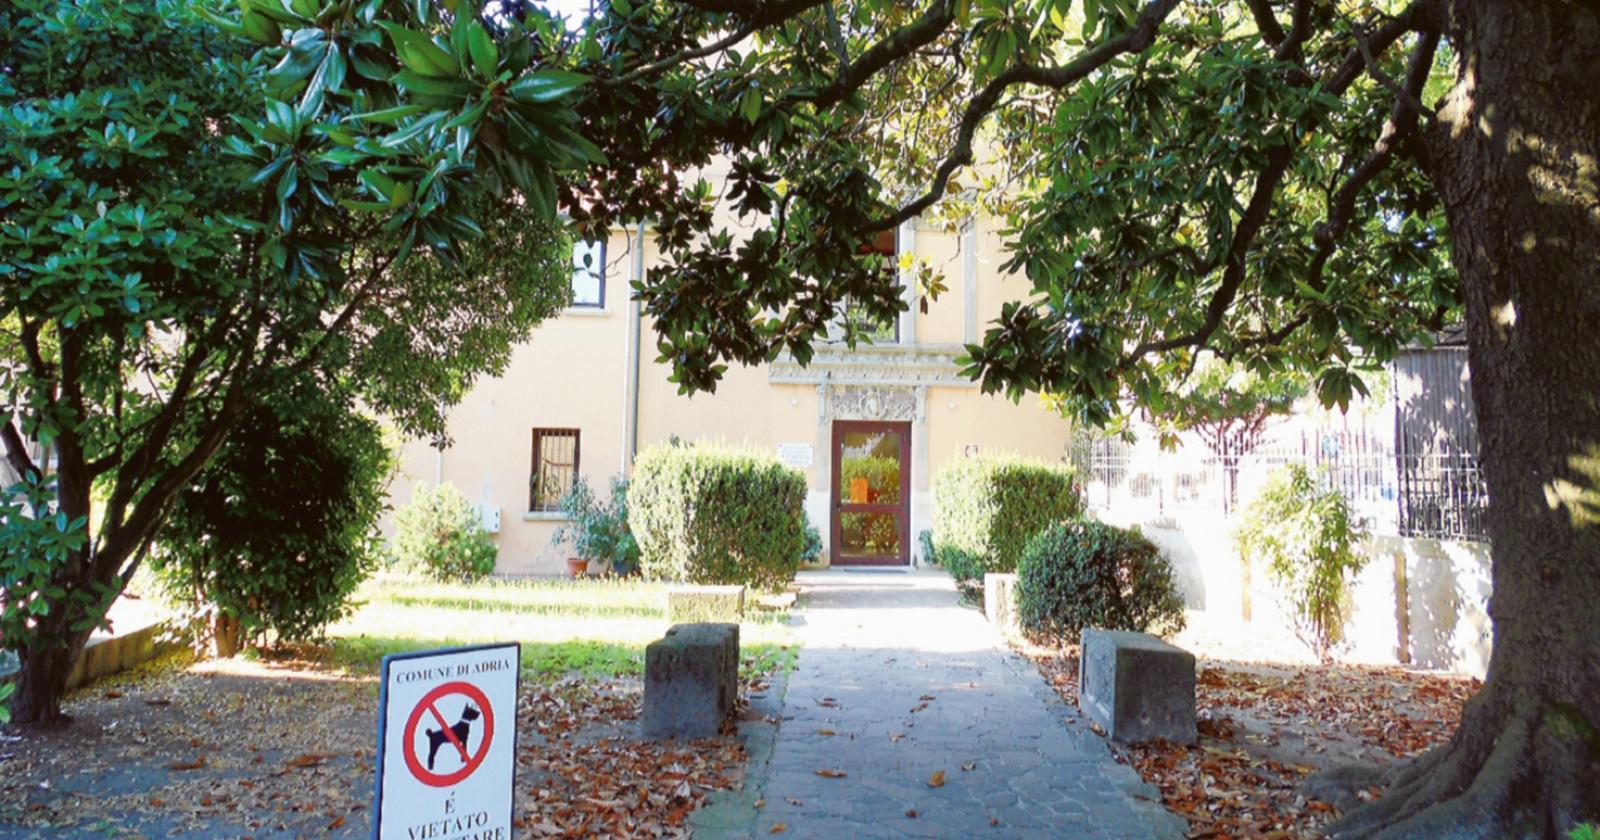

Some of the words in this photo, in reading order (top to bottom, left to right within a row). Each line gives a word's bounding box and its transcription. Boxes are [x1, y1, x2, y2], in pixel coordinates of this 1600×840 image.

[396, 665, 454, 684] COMUNE
[457, 663, 470, 676] DI
[472, 659, 510, 673] ADRIA
[407, 811, 489, 840] VIETATO
